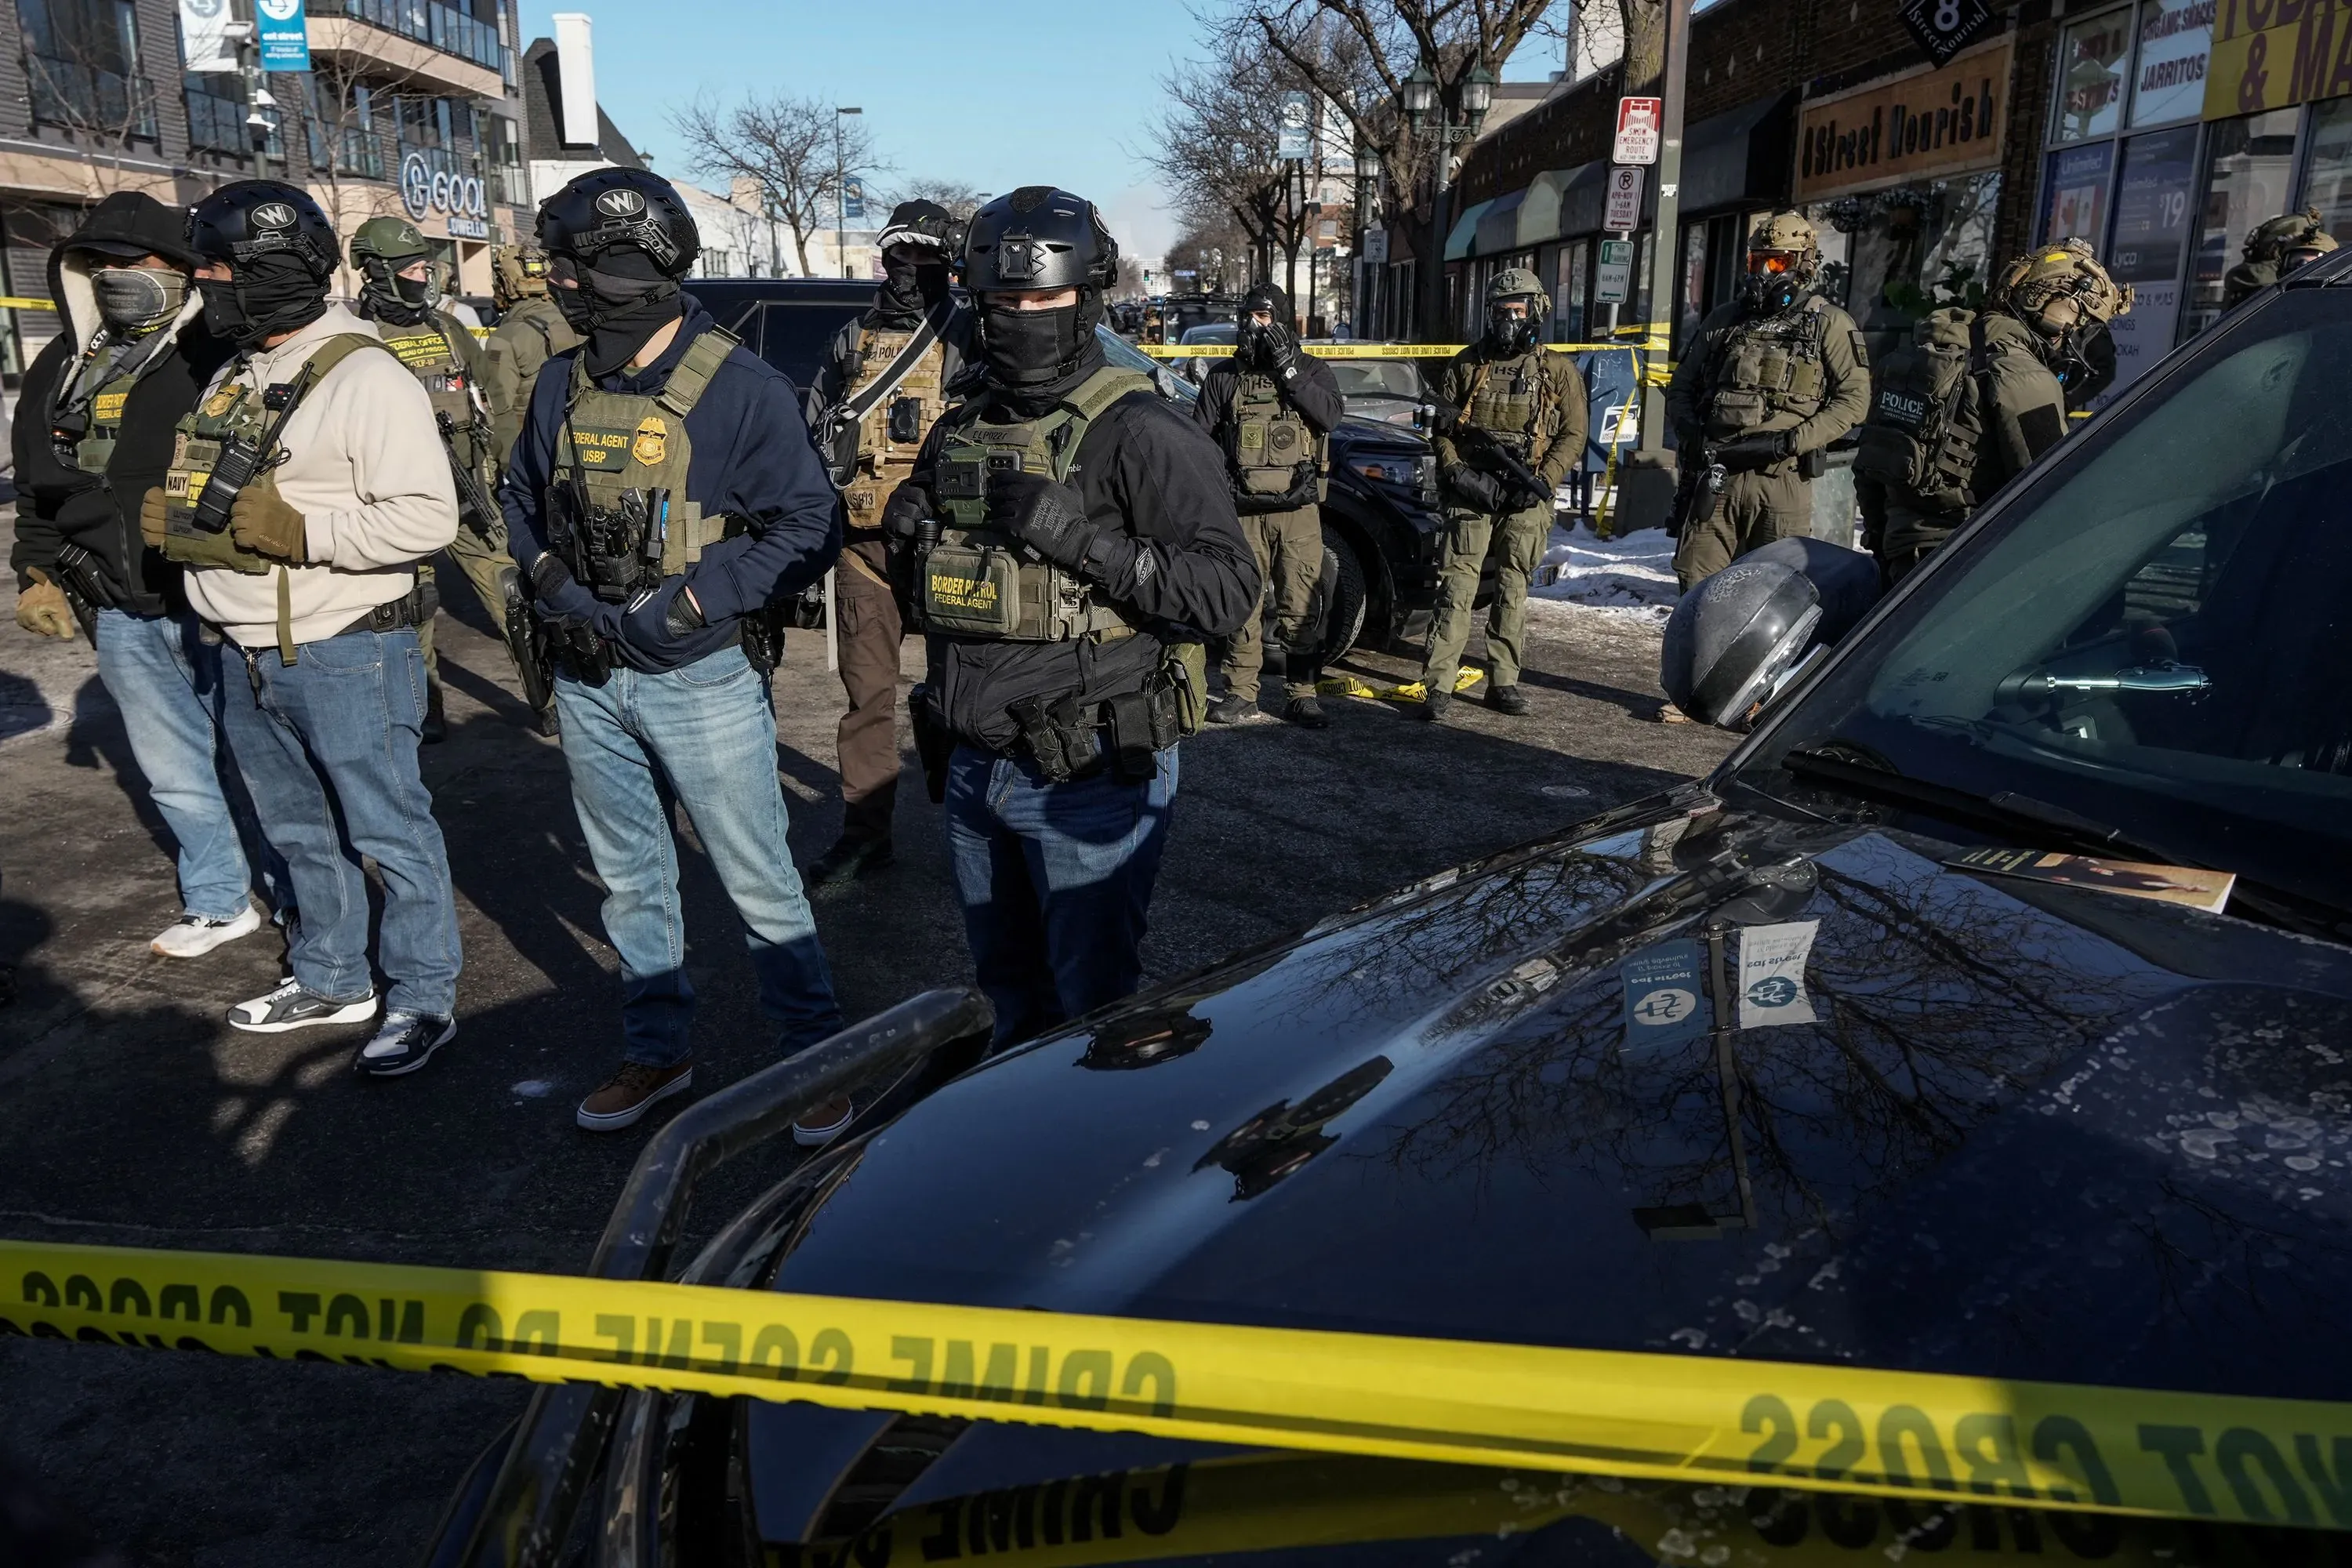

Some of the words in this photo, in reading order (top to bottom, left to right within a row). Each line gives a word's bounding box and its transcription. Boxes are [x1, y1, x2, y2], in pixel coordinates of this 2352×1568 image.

[1908, 10, 1940, 47] Street
[1936, 14, 1985, 58] Nourish
[2140, 53, 2207, 93] JARRITOS
[1888, 78, 1994, 160] Nourish
[1619, 136, 1654, 145] EMERGENCY
[433, 171, 488, 218] GOO
[1610, 209, 1632, 218] TUESDAY
[419, 336, 445, 347] OFFICE
[1882, 391, 1925, 416] POLICE
[601, 434, 629, 448] AGENT
[583, 449, 606, 463] USBP
[167, 475, 187, 492] NAVY
[931, 575, 964, 596] BORDER
[935, 593, 967, 607] FEDERAL
[967, 598, 993, 609] AGENT
